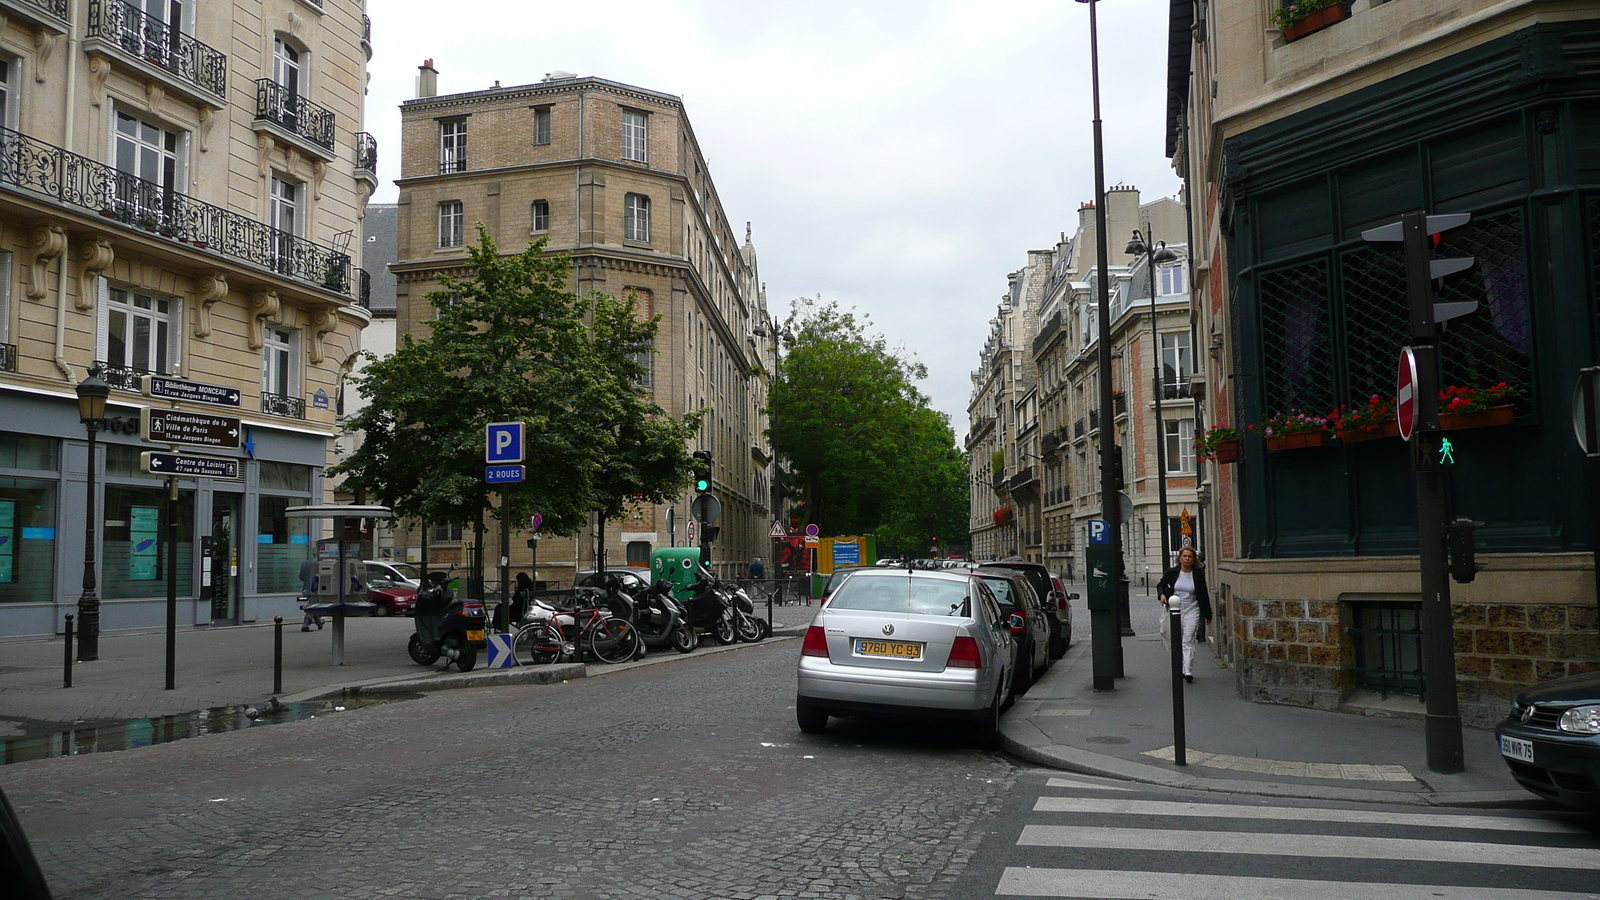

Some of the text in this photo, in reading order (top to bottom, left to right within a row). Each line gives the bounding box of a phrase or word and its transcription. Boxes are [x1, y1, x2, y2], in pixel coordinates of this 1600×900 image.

[164, 381, 227, 396] Bibliothèque MONCEAU
[180, 391, 201, 400] Jacques
[202, 394, 219, 402] Bingen
[165, 414, 211, 426] Cinémathèque
[165, 423, 181, 431] Ville
[192, 426, 208, 434] Paris
[182, 434, 203, 442] Jacques
[203, 436, 221, 444] Bingen
[496, 430, 512, 455] P
[175, 457, 226, 469] Centre de Loisirs
[200, 467, 223, 475] Saussure
[496, 470, 520, 478] ROUES
[1091, 521, 1105, 537] P
[861, 642, 887, 653] 9760
[890, 644, 904, 655] YC
[906, 645, 920, 656] 93
[1523, 743, 1532, 759] 75
